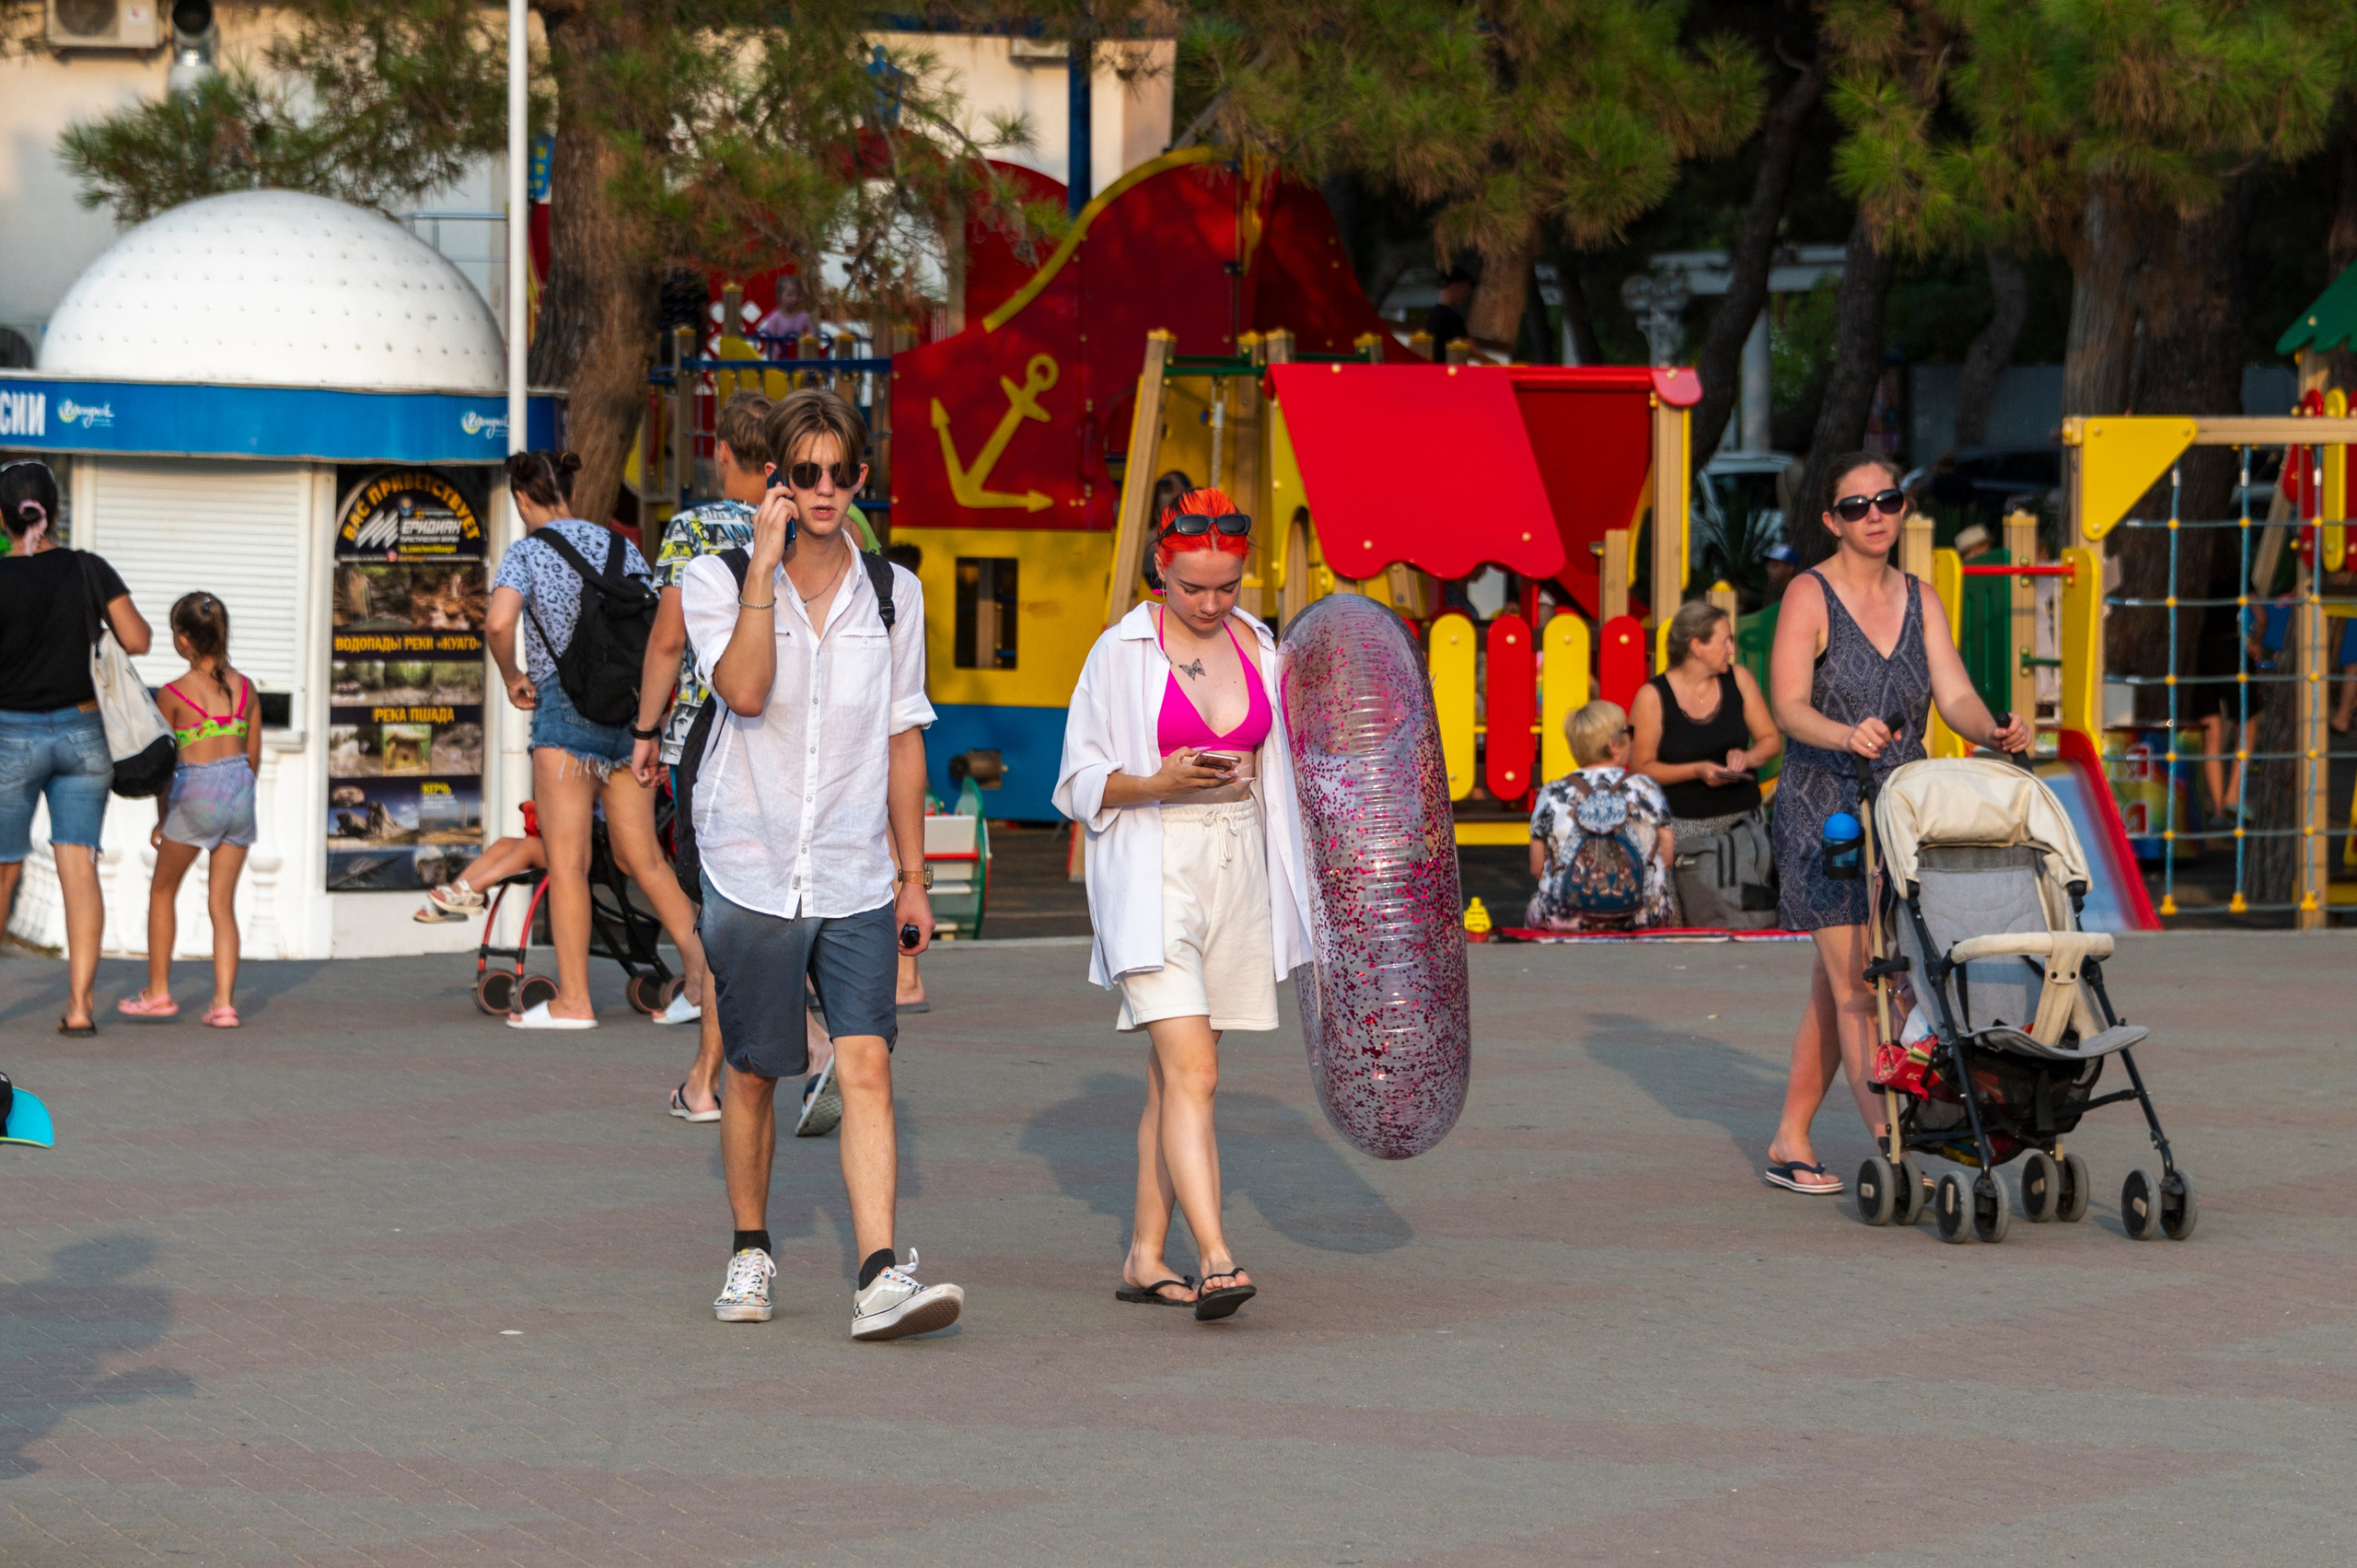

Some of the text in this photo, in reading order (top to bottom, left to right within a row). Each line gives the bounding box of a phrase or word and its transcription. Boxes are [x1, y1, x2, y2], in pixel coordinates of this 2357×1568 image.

[0, 389, 46, 436] СИИ
[342, 471, 481, 541] ВАС ПРИВЕТСТВУЕТ
[334, 635, 482, 653] ВОДОПАДЫ РЕКИ «КУАГО»
[374, 706, 455, 724] РЕКА ПШАДА
[422, 783, 451, 795] КЕРЧЬ
